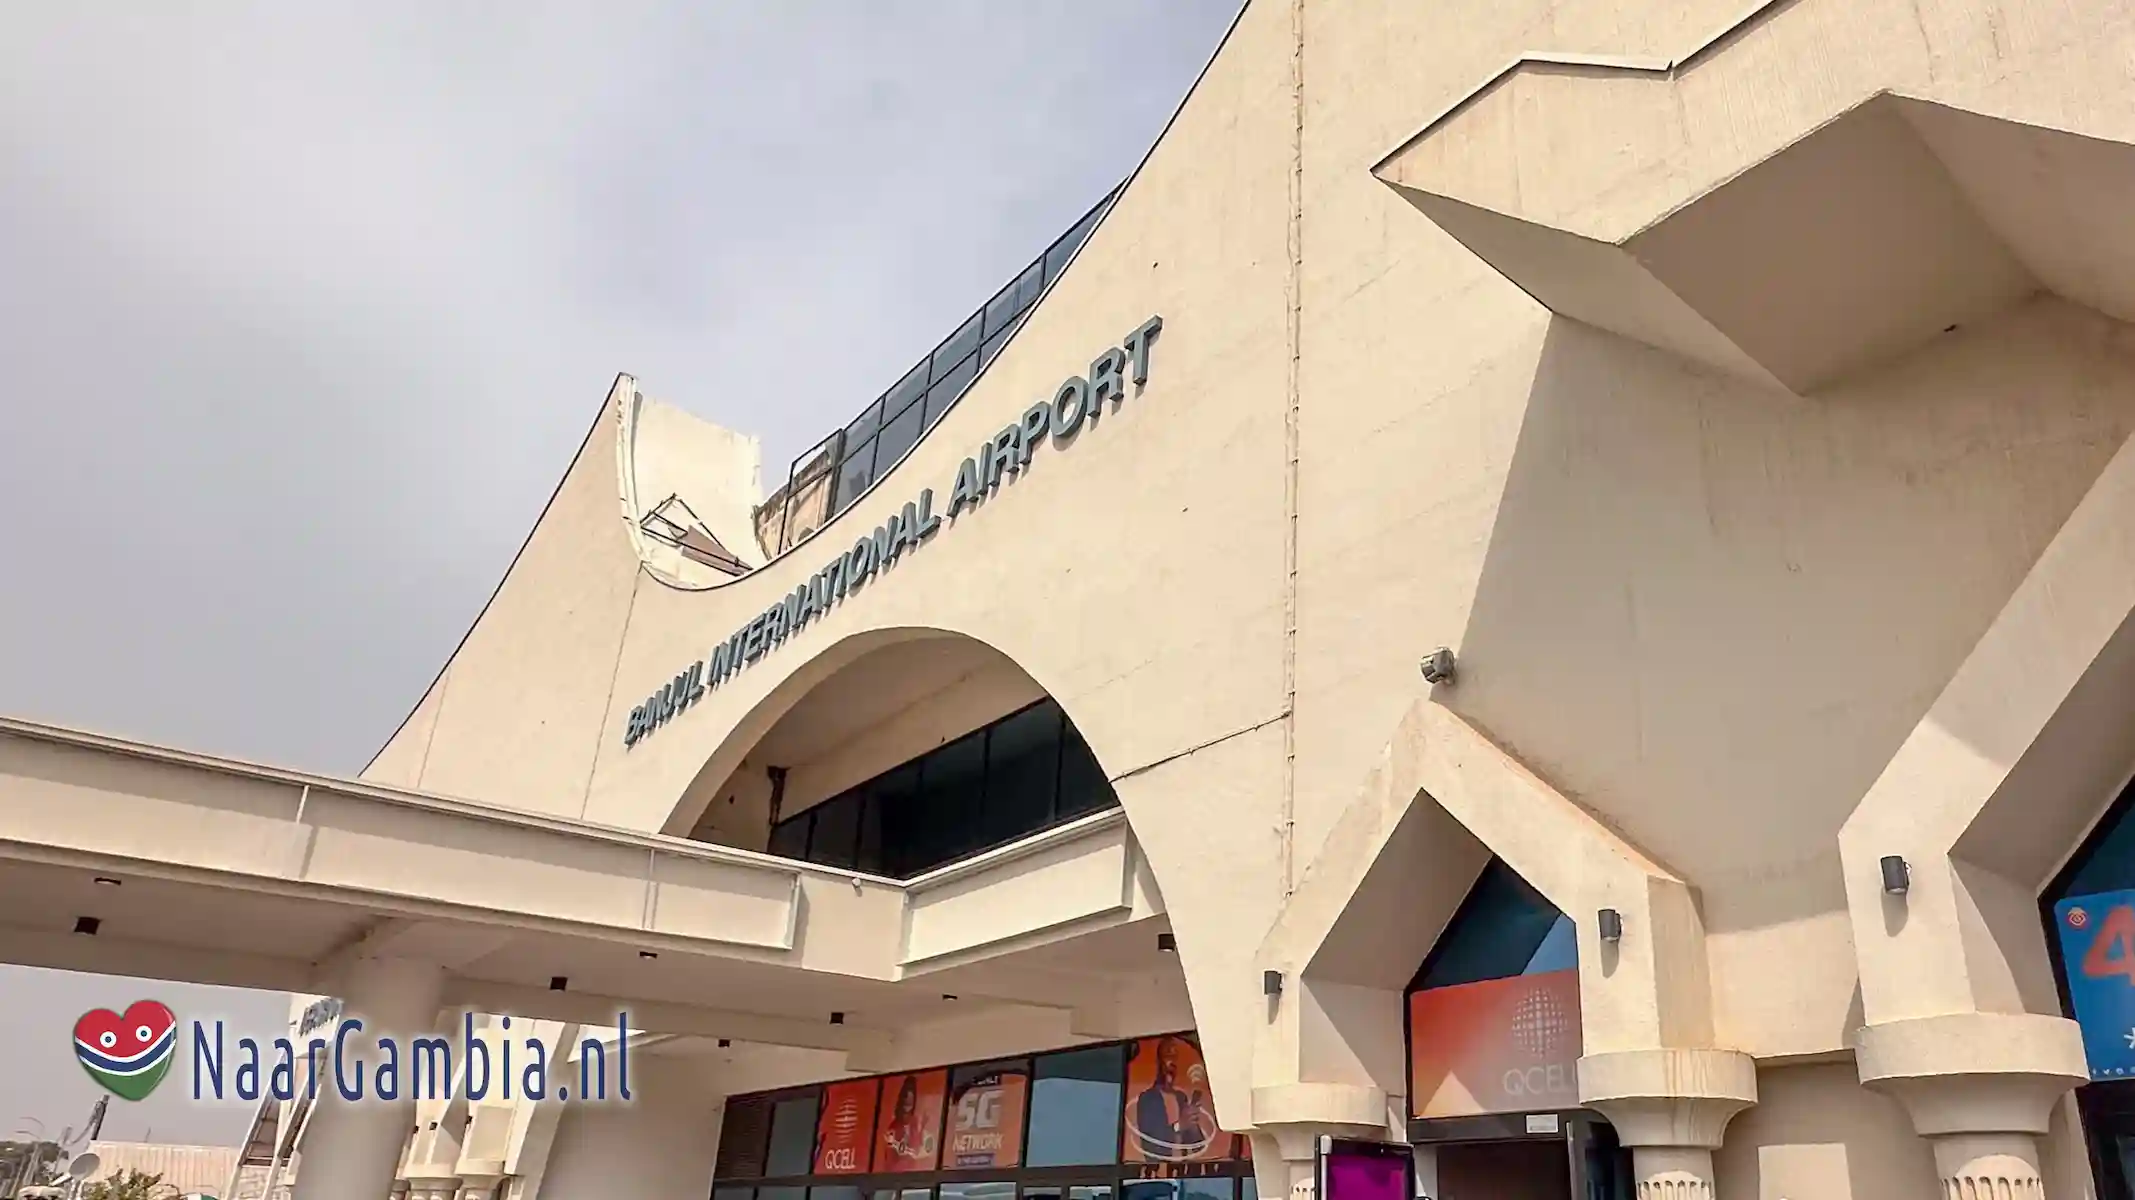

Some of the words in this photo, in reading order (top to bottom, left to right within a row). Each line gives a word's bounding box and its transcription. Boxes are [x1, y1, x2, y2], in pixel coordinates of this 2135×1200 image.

[624, 661, 705, 746] BANJUL
[707, 488, 941, 687] INTERNATIONAL
[946, 315, 1163, 517] AIRPORT
[955, 1090, 1005, 1131] 5G
[953, 1132, 1004, 1153] NETWORK
[825, 1148, 856, 1169] QCELL
